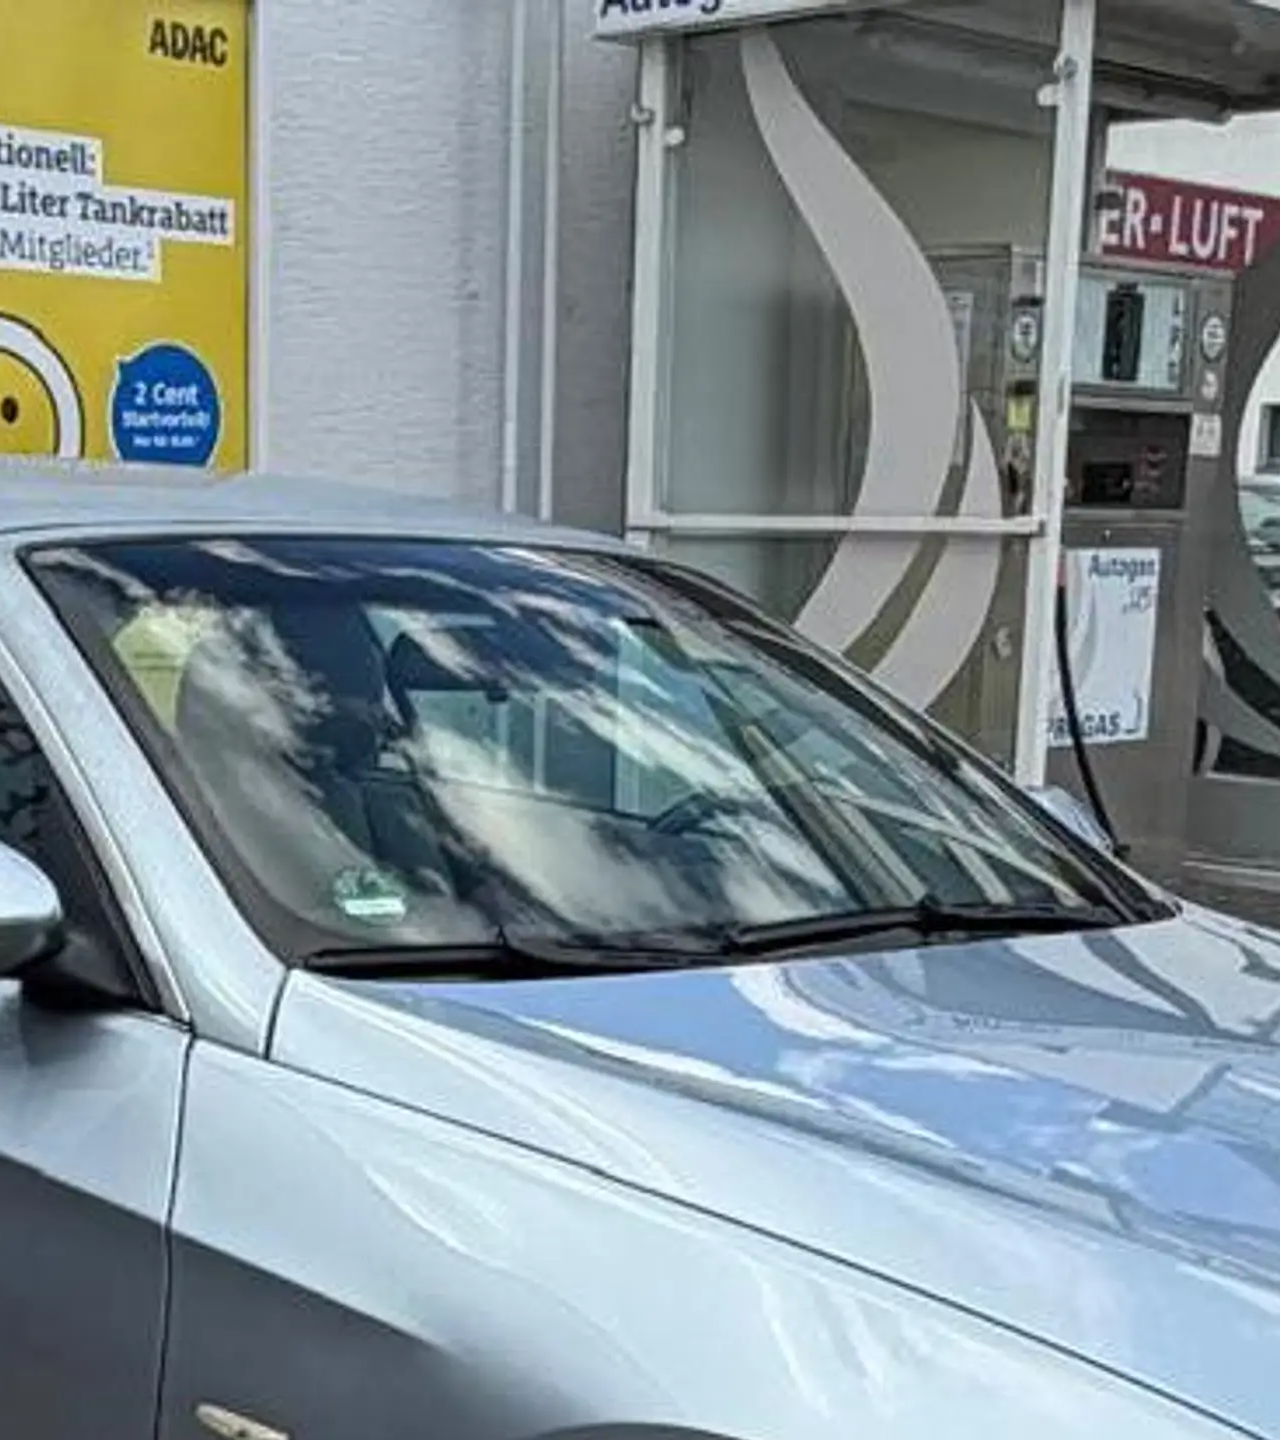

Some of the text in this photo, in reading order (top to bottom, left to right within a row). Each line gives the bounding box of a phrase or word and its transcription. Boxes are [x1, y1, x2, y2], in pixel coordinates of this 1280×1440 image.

[149, 19, 228, 67] ADAC
[76, 191, 229, 236] Tankrabatt
[133, 381, 199, 406] 2 Cent
